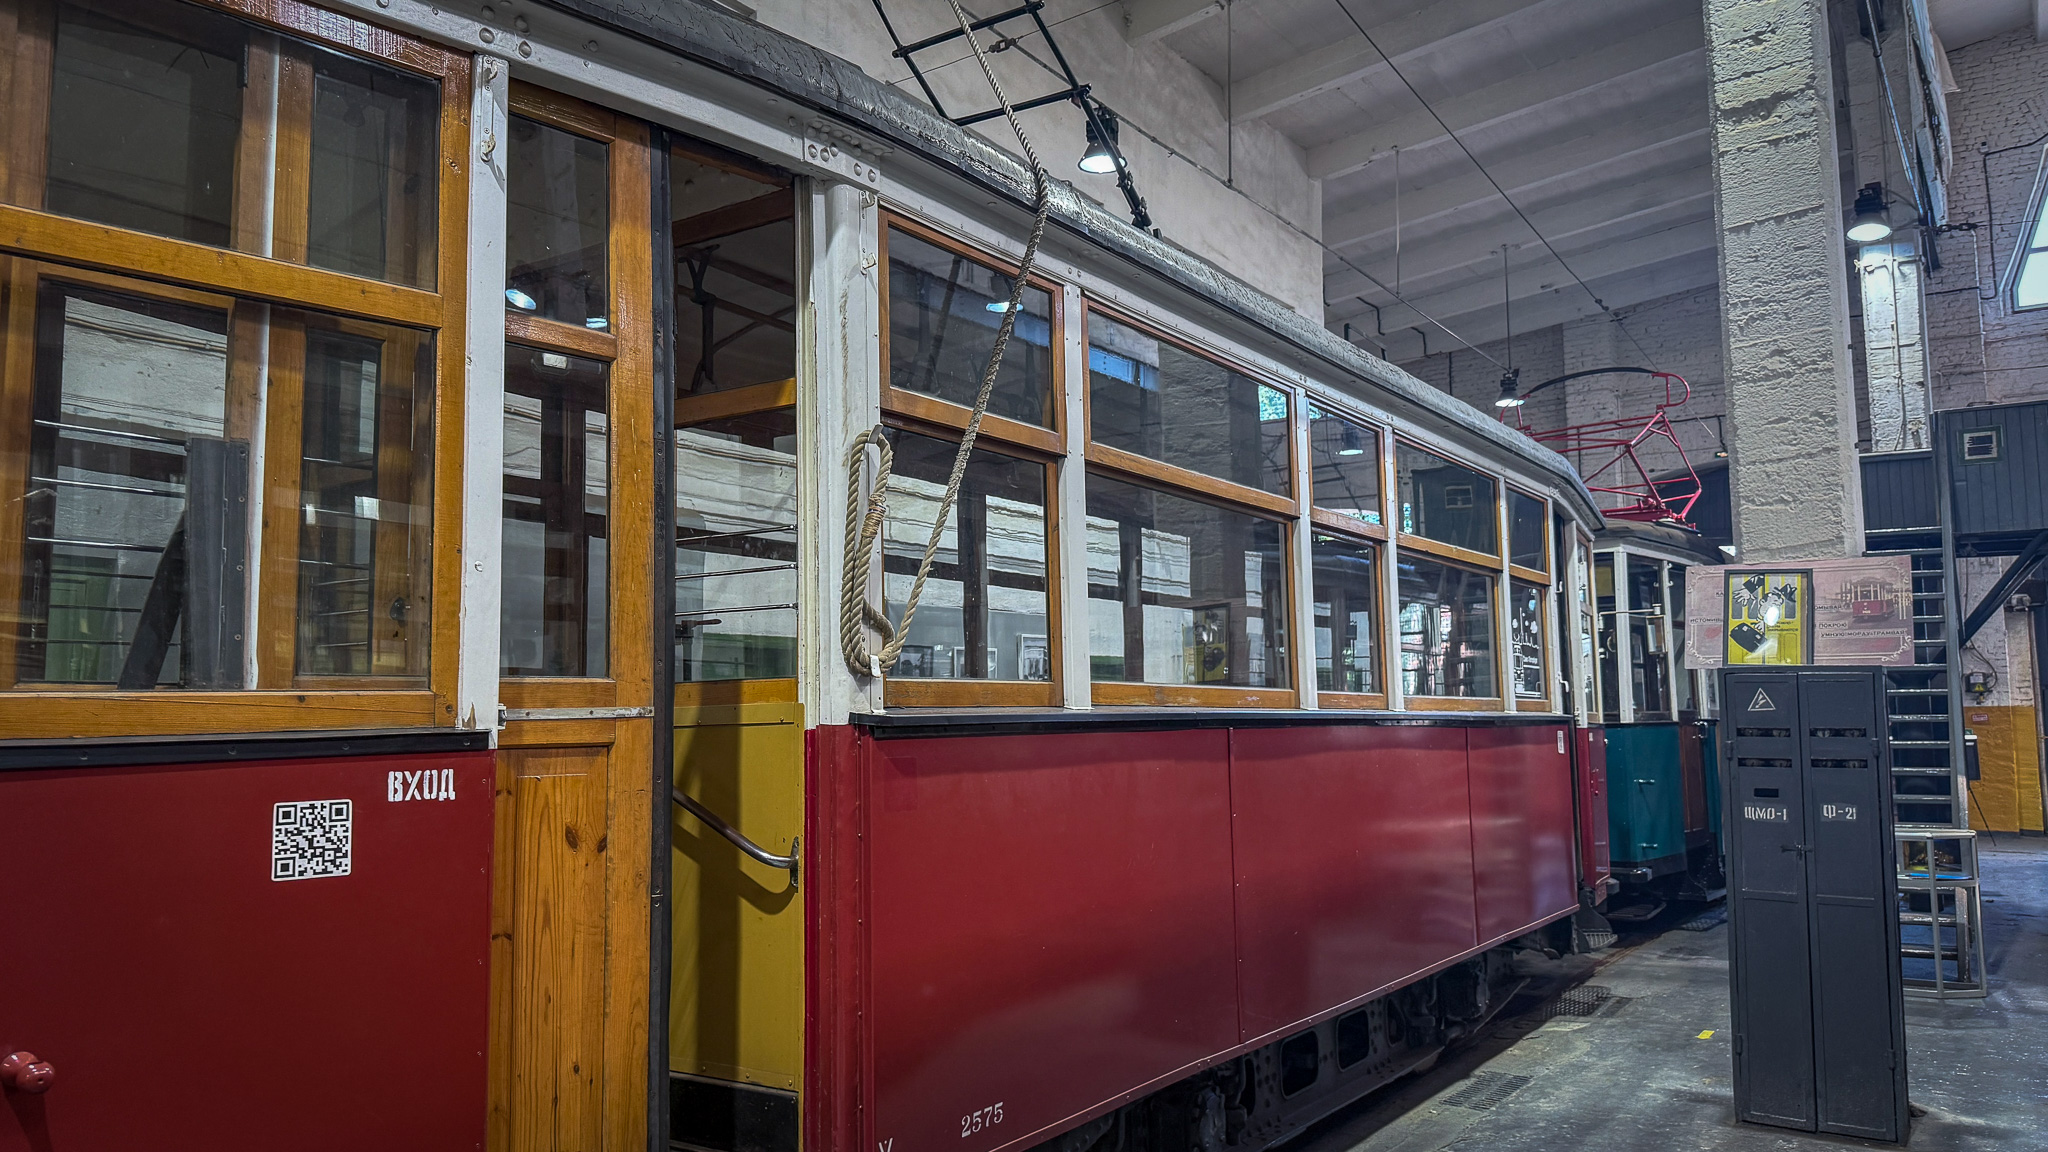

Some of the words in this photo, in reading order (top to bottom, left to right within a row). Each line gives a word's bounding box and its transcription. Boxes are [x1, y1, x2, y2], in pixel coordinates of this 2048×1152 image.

[388, 768, 456, 802] ВХОД
[1744, 806, 1787, 820] ЩМО-1
[1823, 804, 1857, 820] Ф-21
[961, 1101, 1004, 1138] 2575
